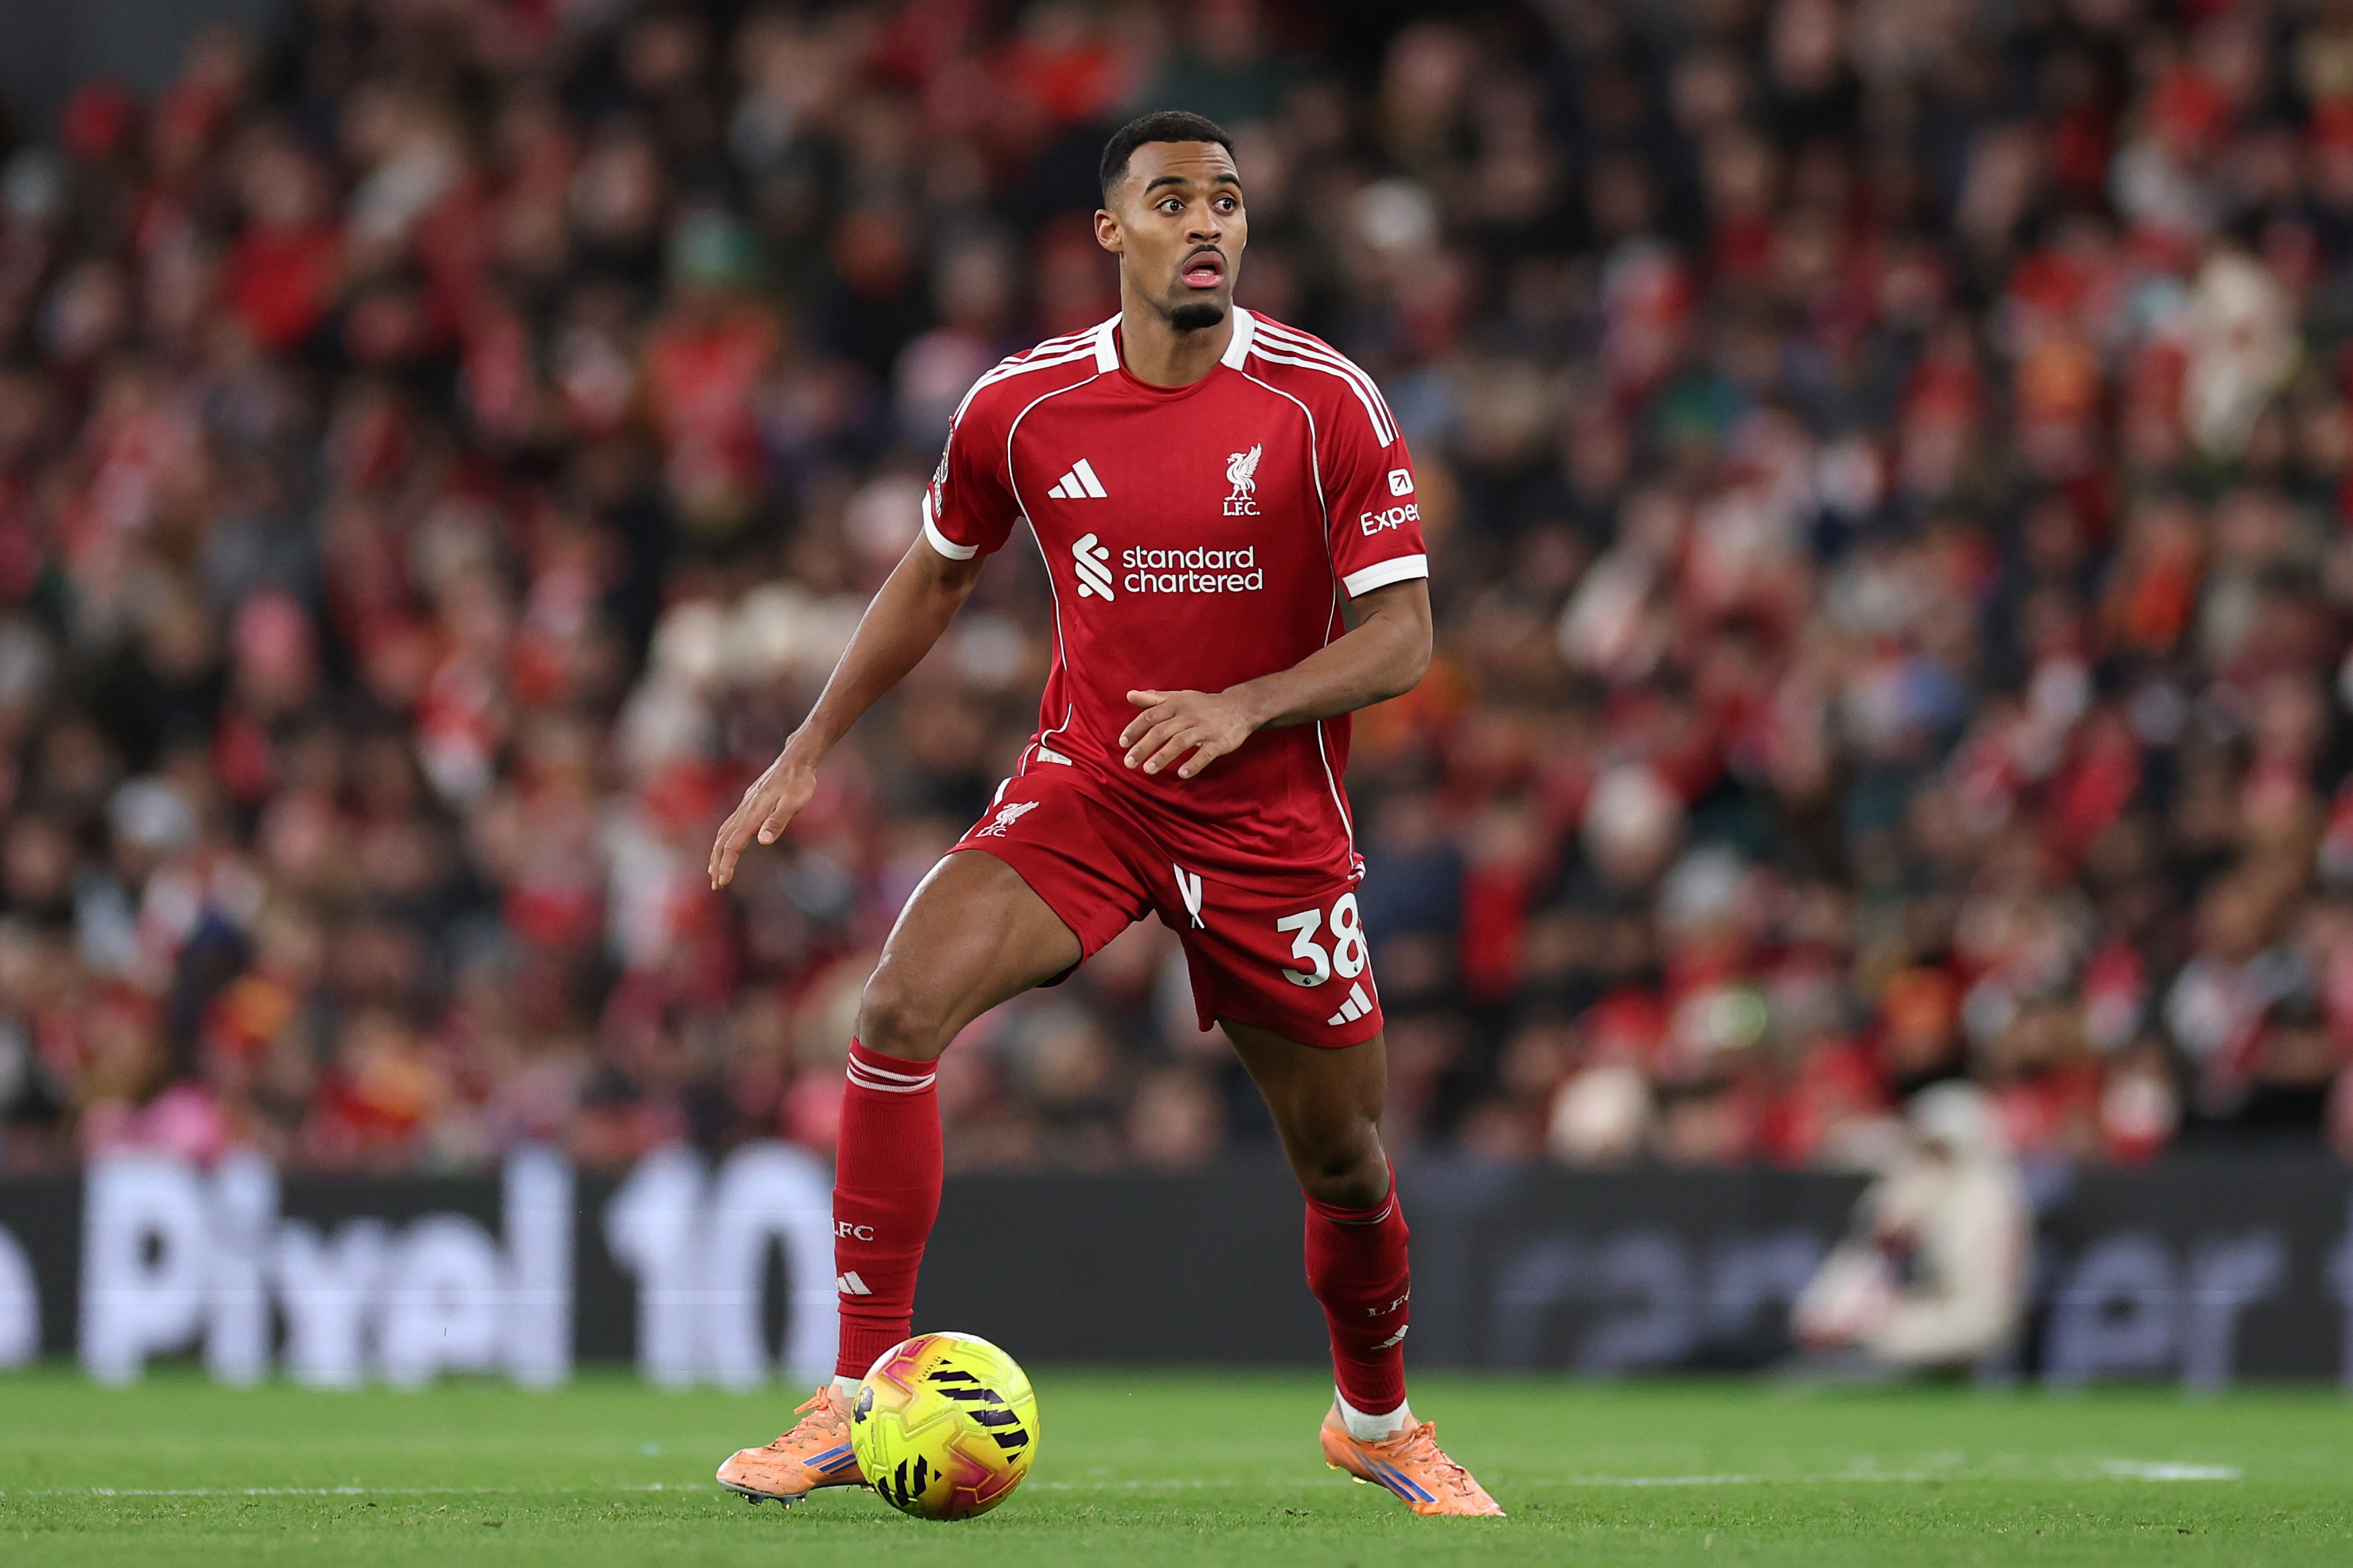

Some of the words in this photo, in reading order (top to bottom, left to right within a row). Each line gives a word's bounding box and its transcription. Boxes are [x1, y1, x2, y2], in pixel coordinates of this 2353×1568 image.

[1223, 502, 1260, 516] L.F.C.
[1122, 545, 1254, 568] standard
[1123, 568, 1263, 593] chartered
[1276, 892, 1365, 987] 38
[79, 1144, 574, 1388] Pixel
[603, 1141, 838, 1389] 10
